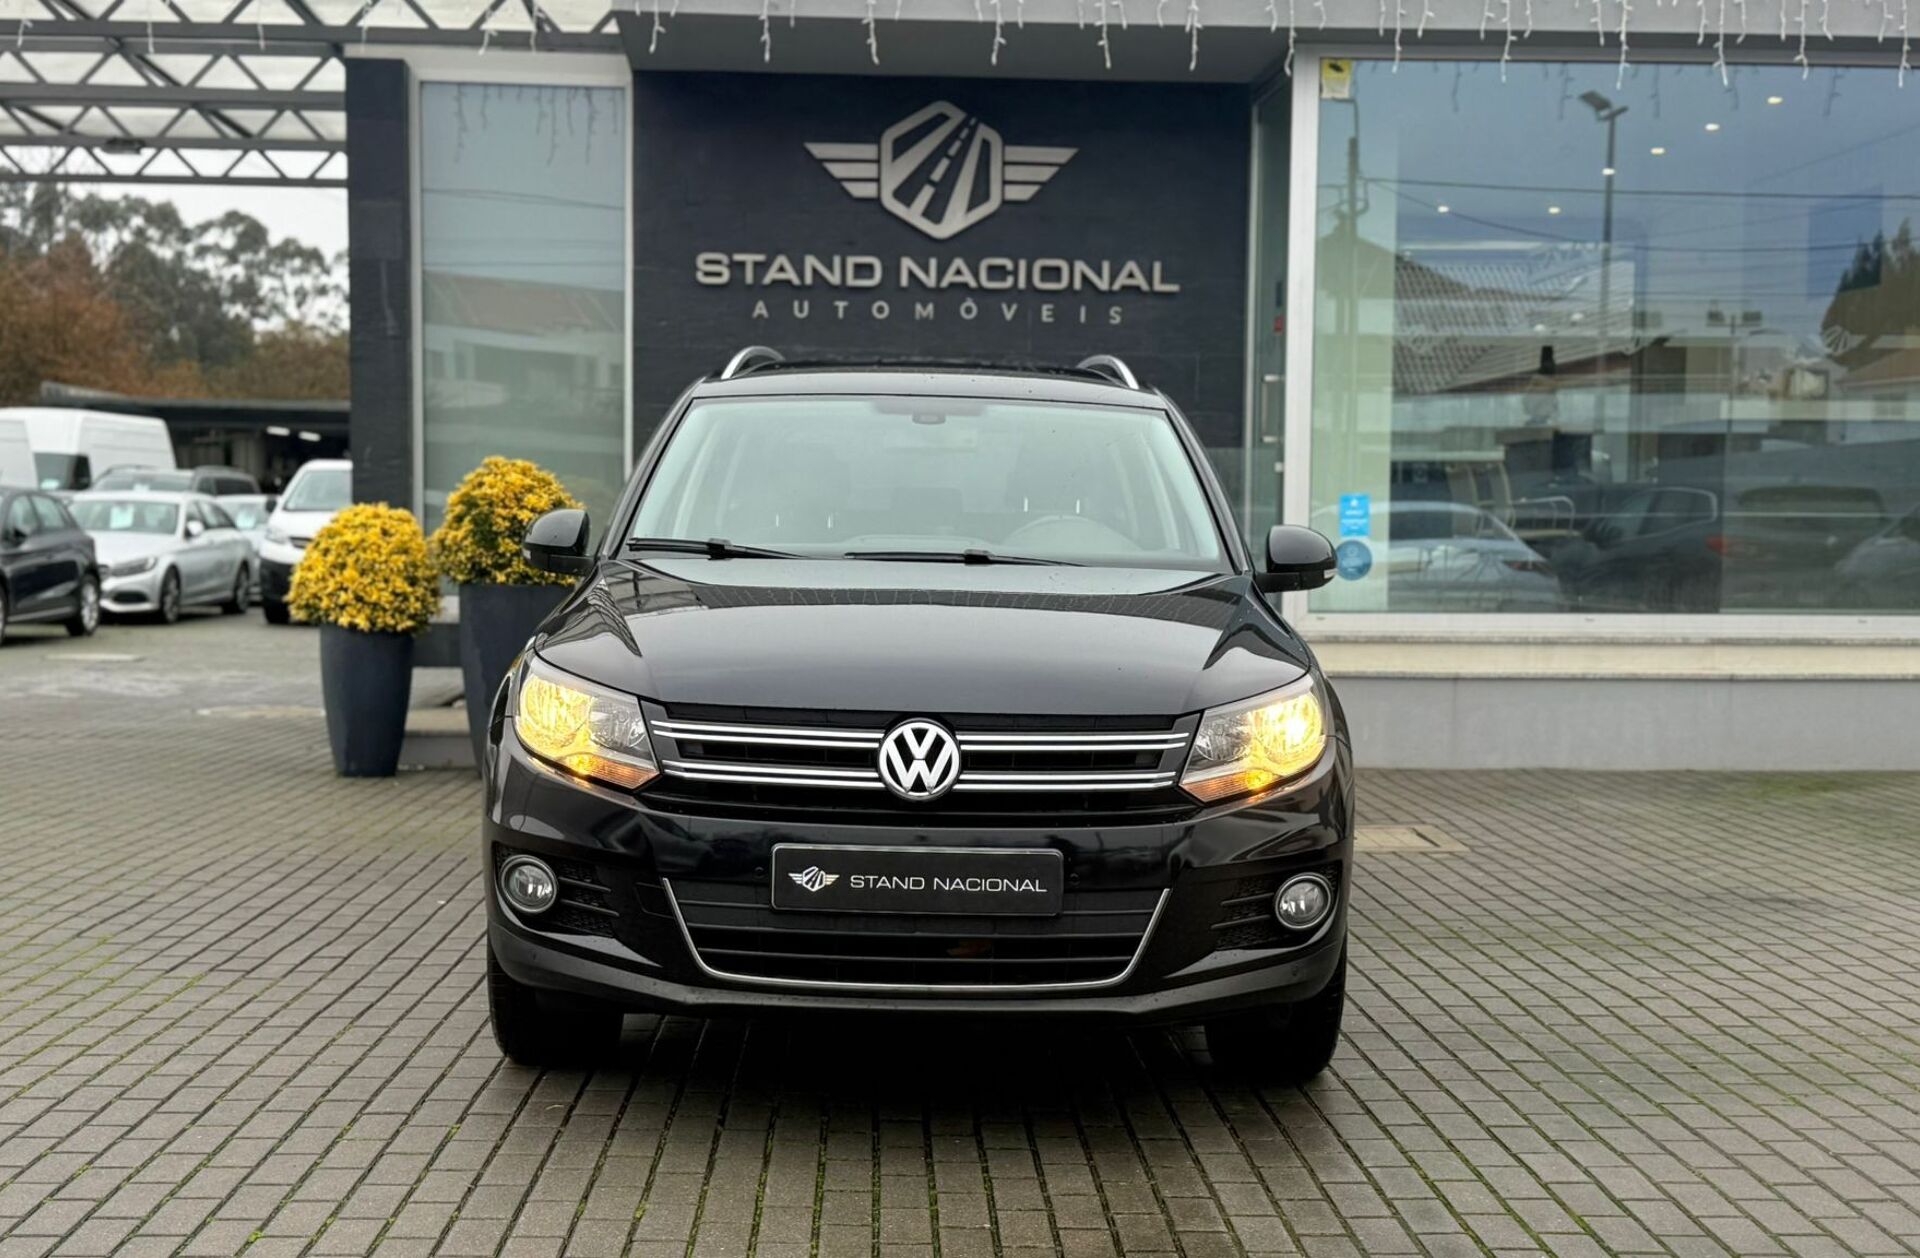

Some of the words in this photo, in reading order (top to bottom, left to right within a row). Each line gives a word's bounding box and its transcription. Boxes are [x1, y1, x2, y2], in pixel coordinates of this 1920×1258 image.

[695, 252, 883, 286] STAND
[899, 256, 1180, 292] NACIONAL
[883, 722, 957, 797] VW
[850, 875, 925, 890] STAND
[933, 877, 1047, 892] NACIONAL
